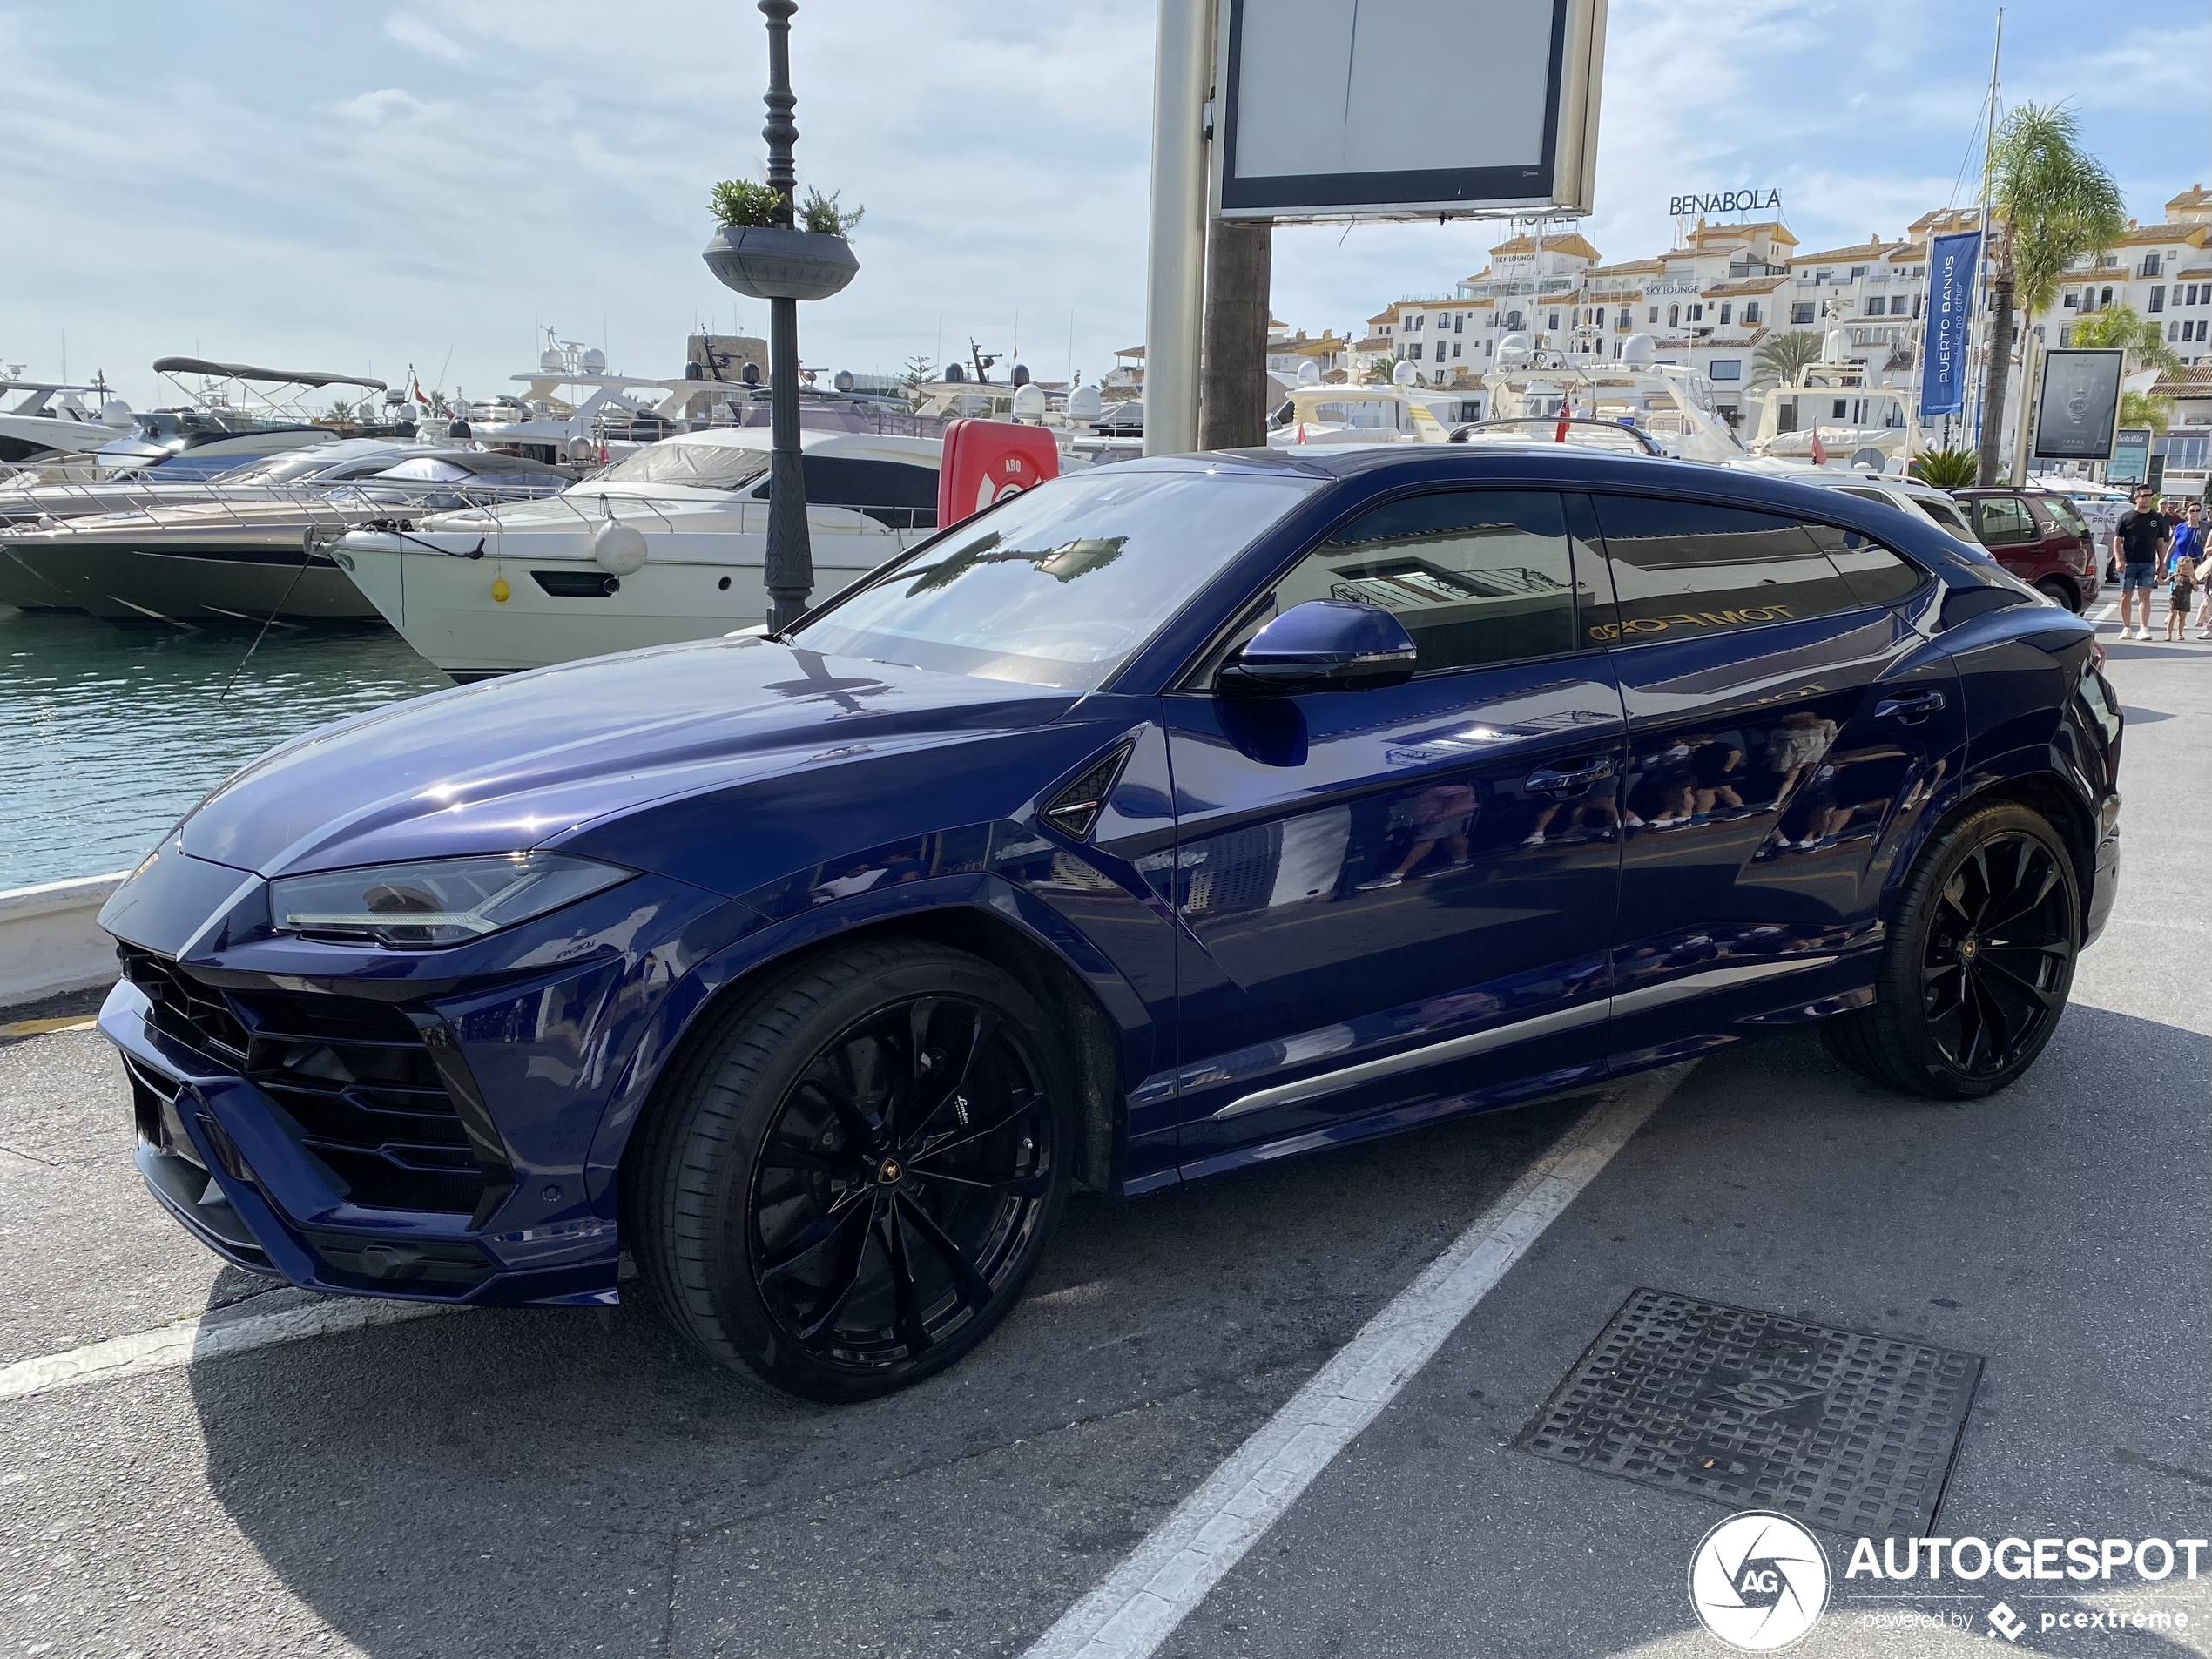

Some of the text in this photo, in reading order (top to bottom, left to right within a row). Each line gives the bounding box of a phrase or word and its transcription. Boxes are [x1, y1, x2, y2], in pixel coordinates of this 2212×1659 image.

[1669, 187, 1781, 216] BENABOLA
[1495, 253, 1535, 264] SKY LOUNGE
[1645, 285, 1699, 295] SKY LOUNGE
[1953, 281, 1964, 313] other
[1939, 255, 1955, 383] PUERTO BANÚS
[2117, 433, 2144, 442] Solvilla
[1005, 459, 1022, 473] ARO
